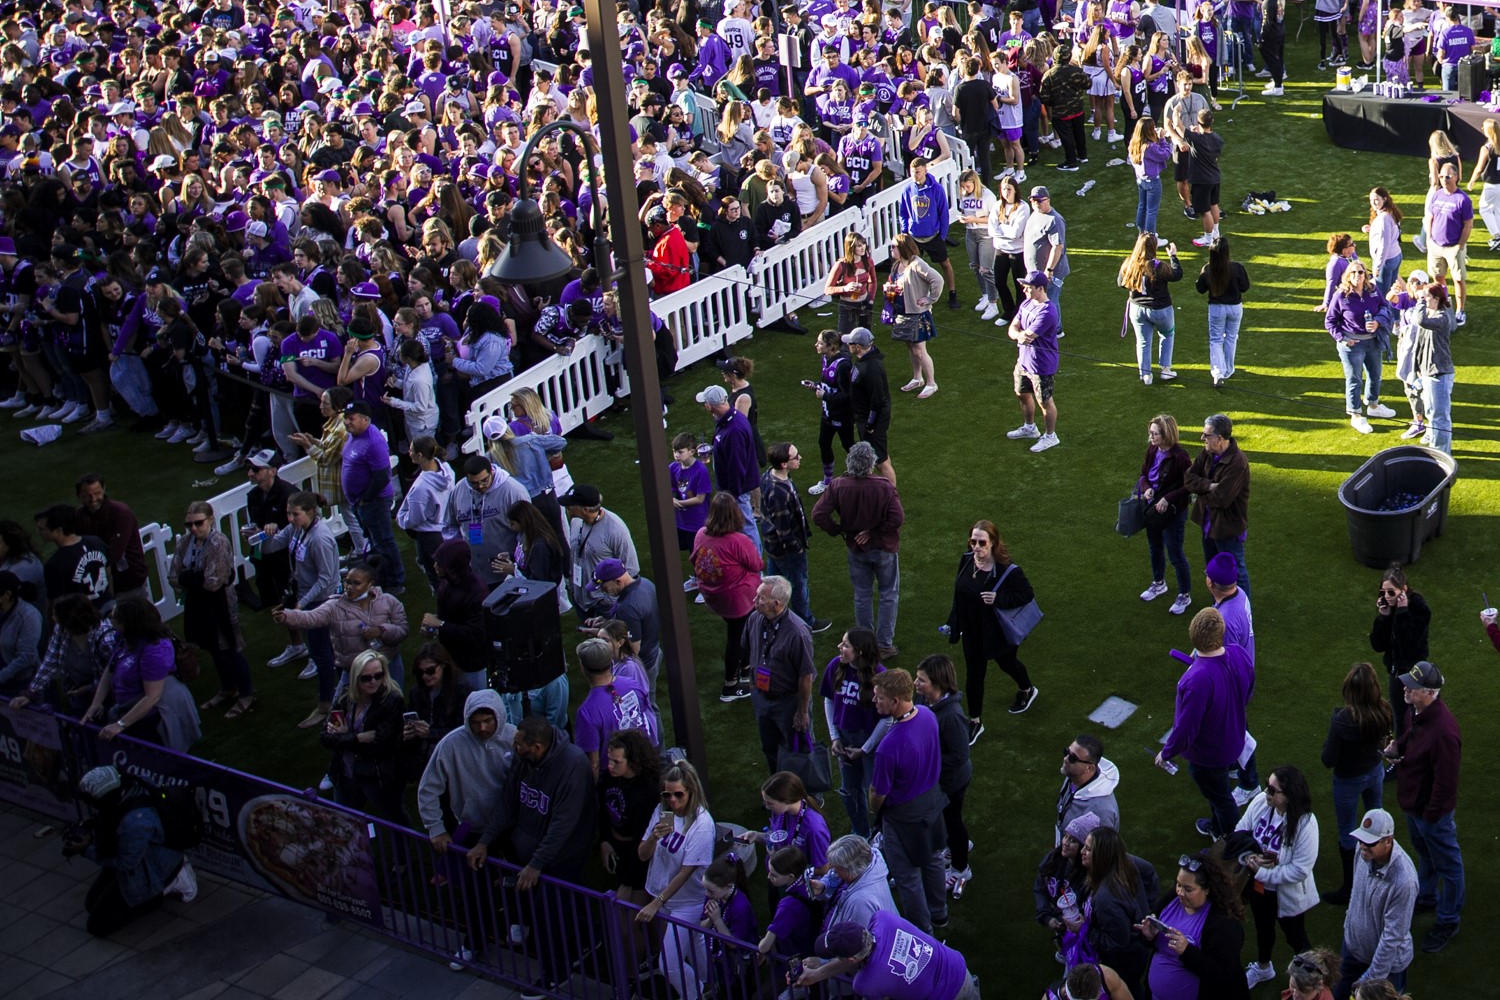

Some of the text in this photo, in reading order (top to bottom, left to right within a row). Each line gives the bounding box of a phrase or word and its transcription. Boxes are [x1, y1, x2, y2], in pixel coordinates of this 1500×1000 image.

[725, 34, 744, 49] 49
[845, 157, 870, 170] GCU
[851, 170, 860, 184] 4
[300, 348, 326, 360] GCU
[518, 780, 550, 816] GCU
